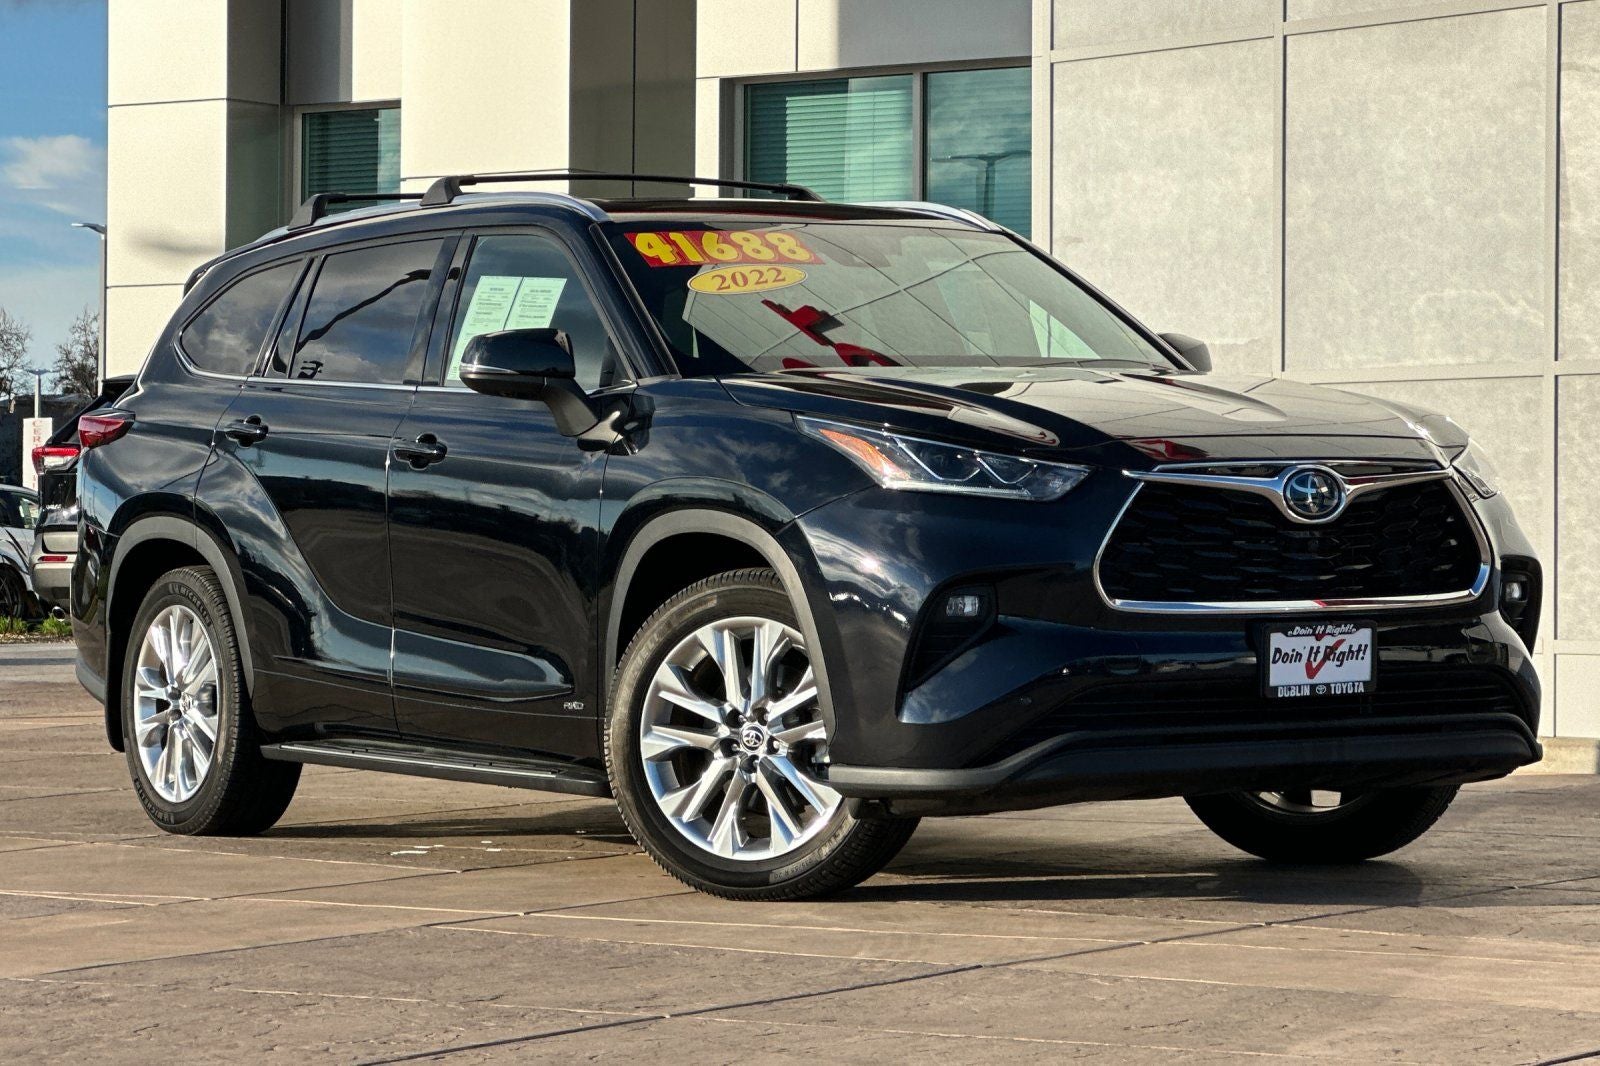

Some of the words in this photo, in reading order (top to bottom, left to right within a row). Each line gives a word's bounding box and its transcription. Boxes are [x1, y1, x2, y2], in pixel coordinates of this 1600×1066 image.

[635, 231, 811, 264] 41688
[711, 267, 786, 291] 2022
[1271, 646, 1306, 664] Doin'
[1307, 645, 1321, 662] It
[1323, 644, 1369, 667] Right!
[1277, 685, 1310, 698] DUBLIN
[1330, 682, 1365, 694] TOYOTA
